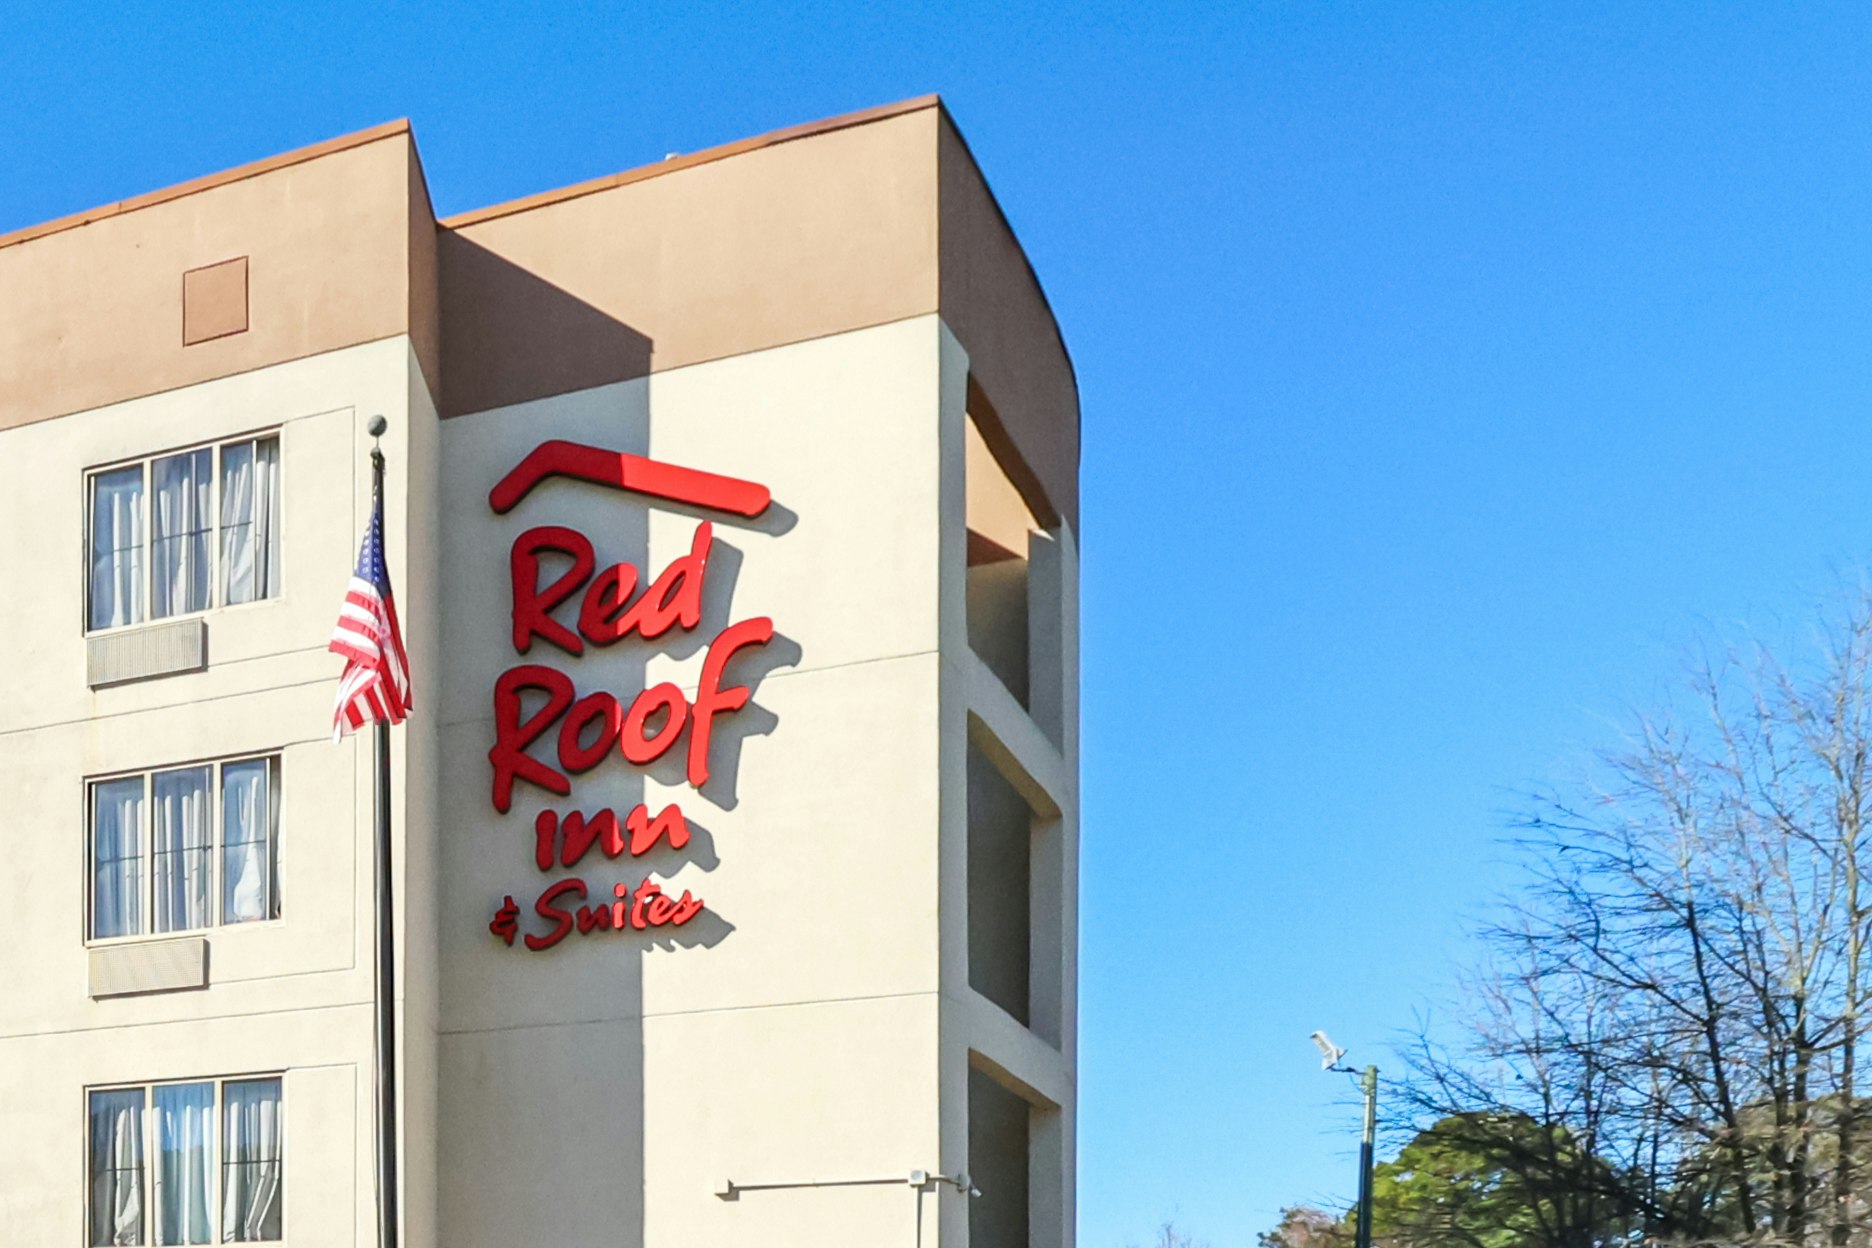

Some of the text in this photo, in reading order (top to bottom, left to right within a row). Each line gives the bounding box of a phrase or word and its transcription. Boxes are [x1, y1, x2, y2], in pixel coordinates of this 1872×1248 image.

[510, 520, 713, 657] Red
[488, 616, 774, 815] Roof
[489, 878, 704, 951] & Suites
